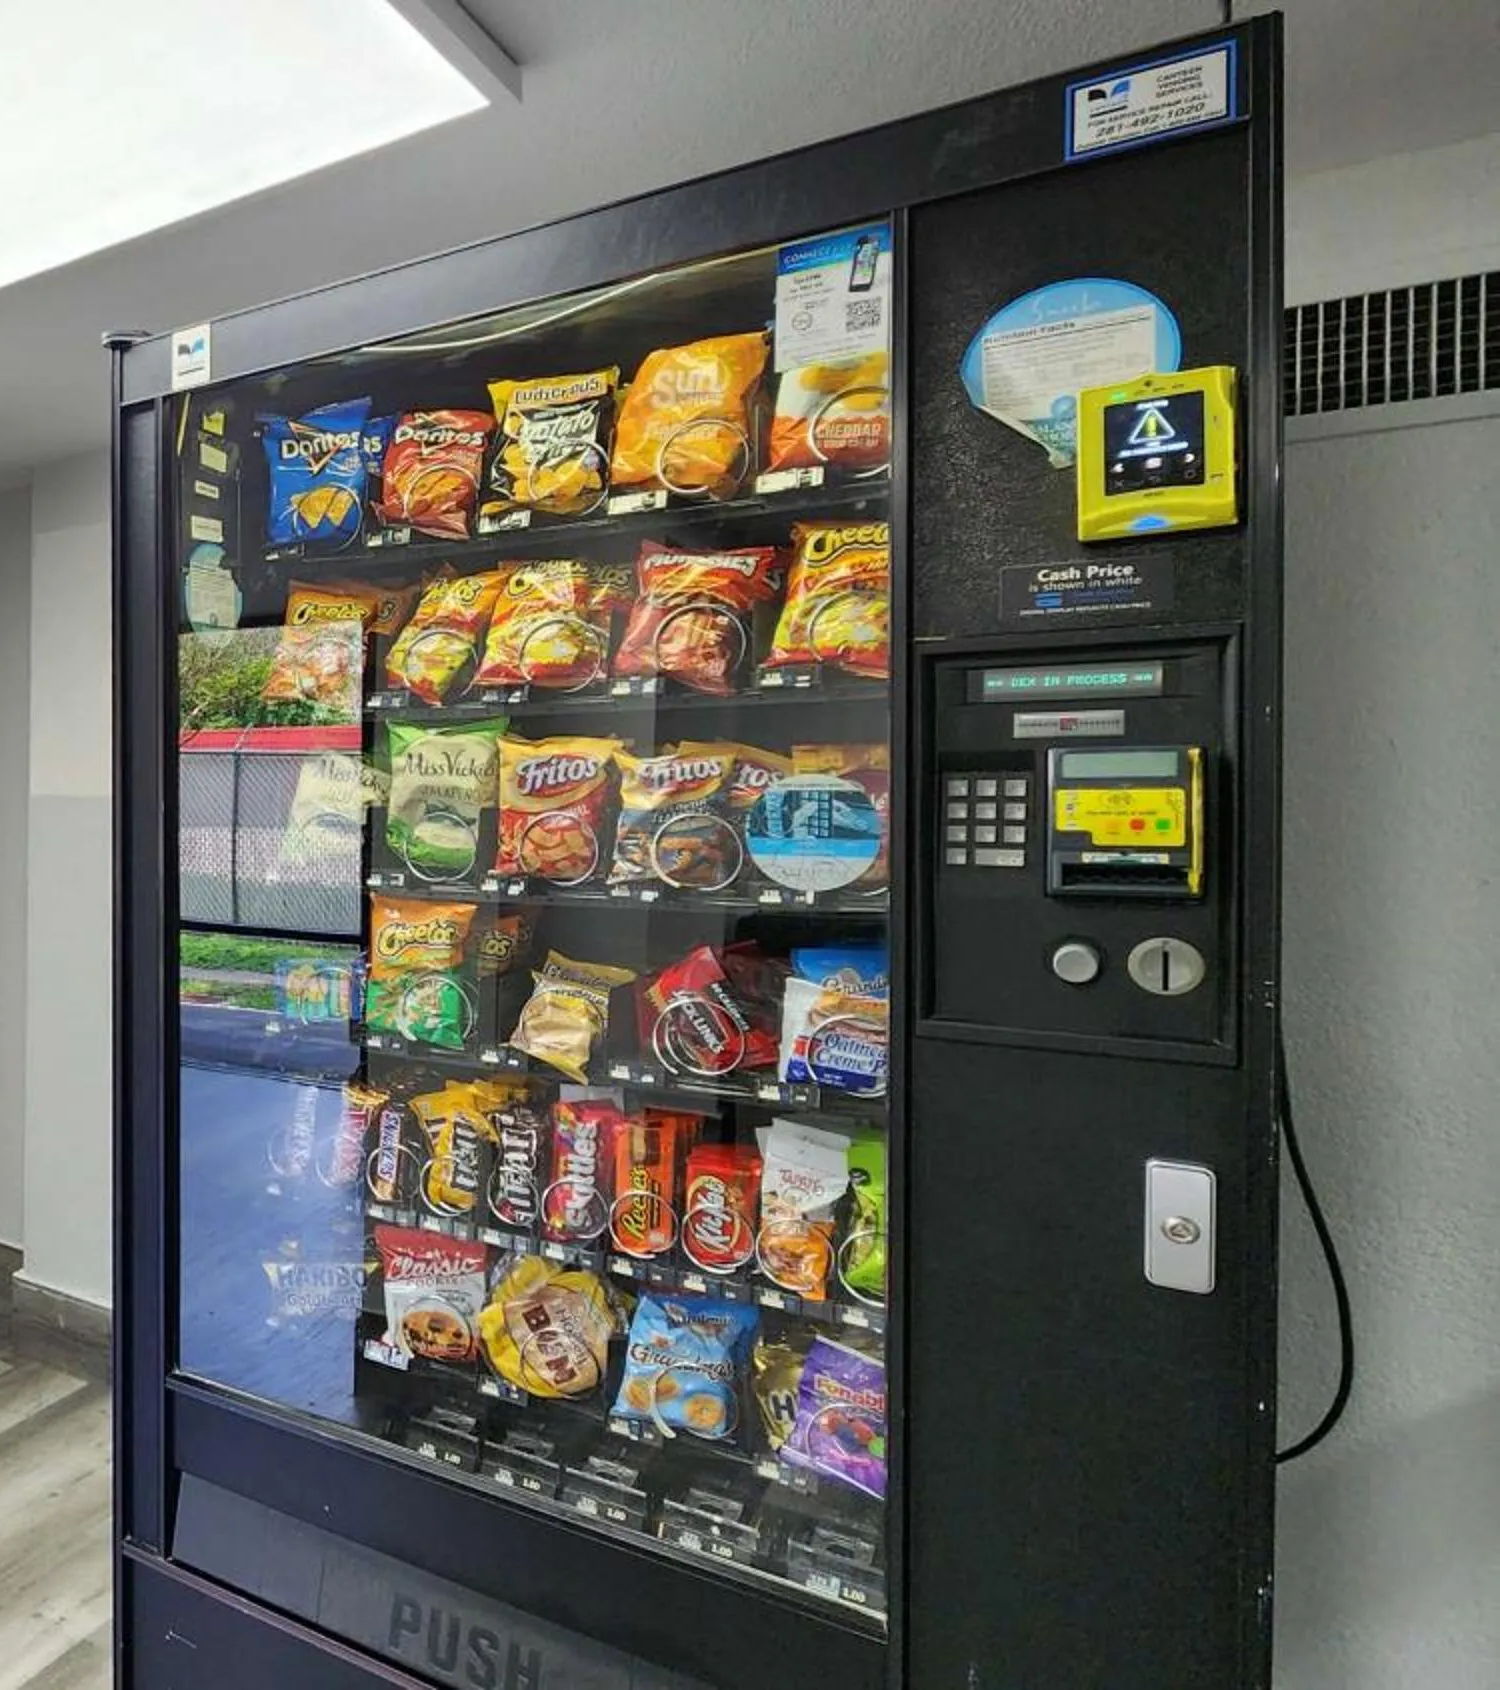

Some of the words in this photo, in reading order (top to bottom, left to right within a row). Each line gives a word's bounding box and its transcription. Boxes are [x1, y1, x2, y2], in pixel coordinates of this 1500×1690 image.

[281, 430, 360, 460] Doritos
[394, 424, 485, 449] Doritos
[1037, 567, 1081, 582] Cash
[1087, 564, 1135, 579] Price
[1067, 672, 1128, 686] PROCESS
[404, 751, 444, 777] Miss
[517, 753, 599, 796] Fritos
[377, 920, 458, 960] Cheetos
[621, 1166, 650, 1241] Reese's
[387, 1250, 484, 1281] Classic
[388, 1593, 541, 1690] PUSH
